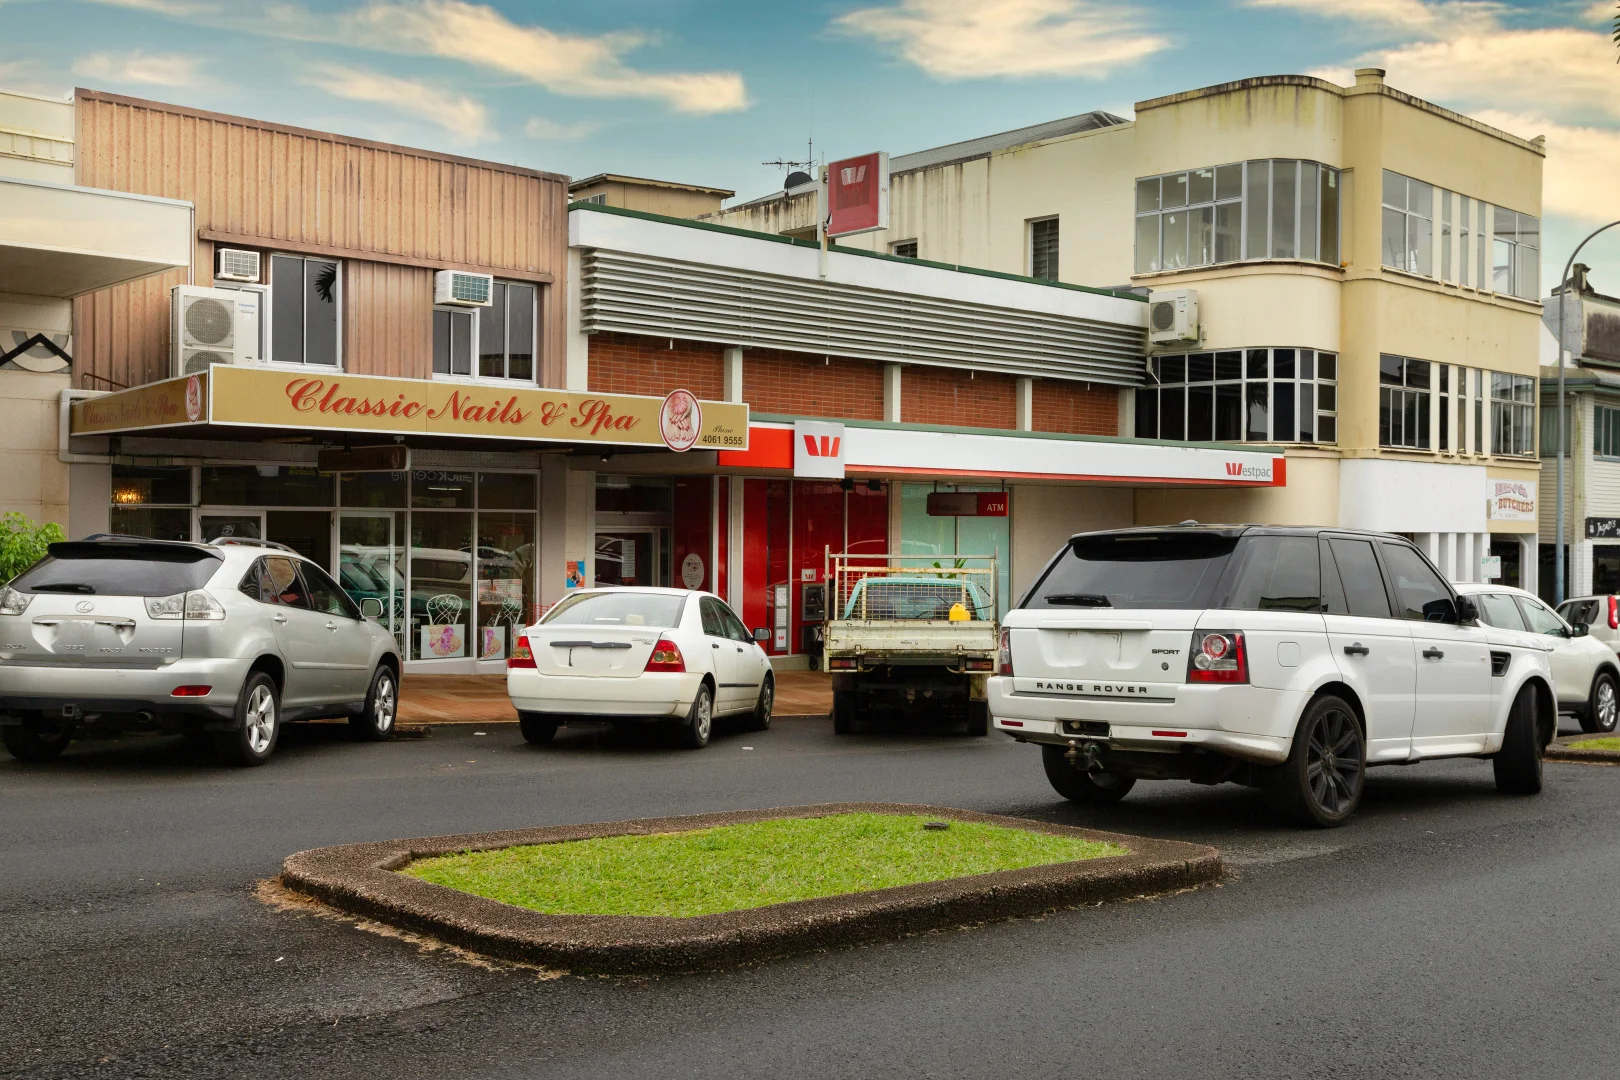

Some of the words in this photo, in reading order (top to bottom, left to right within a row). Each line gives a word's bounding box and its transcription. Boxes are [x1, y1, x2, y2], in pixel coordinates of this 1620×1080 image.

[285, 378, 427, 418] Classic
[427, 390, 532, 425] Nails
[541, 401, 568, 427] &
[570, 399, 642, 436] Spa
[712, 424, 734, 434] Phone
[702, 435, 721, 444] 4061
[724, 436, 743, 445] 9555
[1225, 462, 1271, 479] Westpac
[986, 503, 1004, 512] ATM
[1498, 497, 1534, 513] BUTCHERS
[1036, 682, 1084, 692] RANGE
[1093, 685, 1148, 694] ROVER
